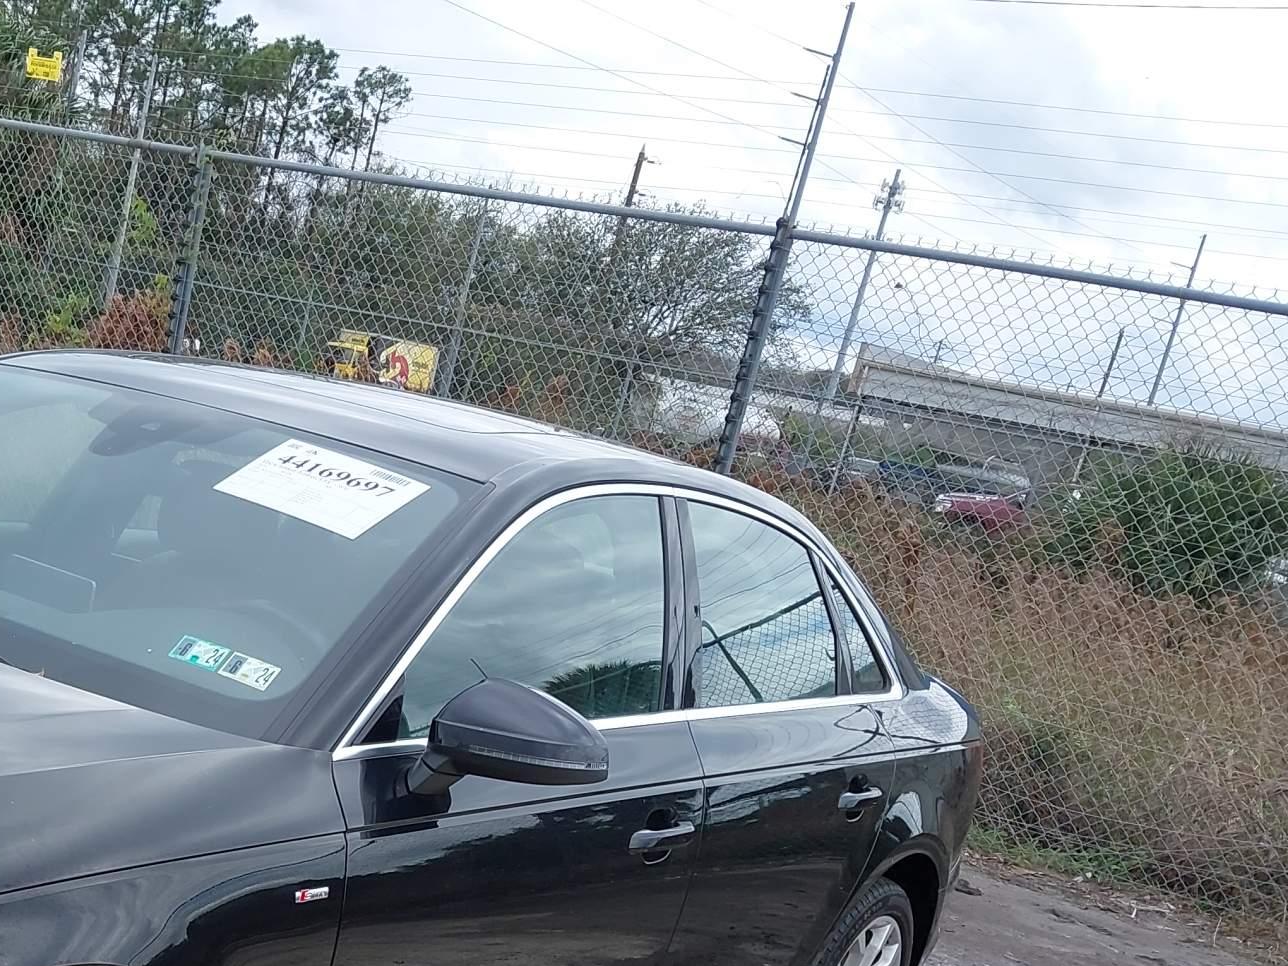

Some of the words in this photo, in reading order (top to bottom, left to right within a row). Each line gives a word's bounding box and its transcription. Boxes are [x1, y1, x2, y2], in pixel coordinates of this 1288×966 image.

[277, 455, 396, 497] 44169697
[205, 649, 225, 665] 24
[255, 668, 276, 686] 24
